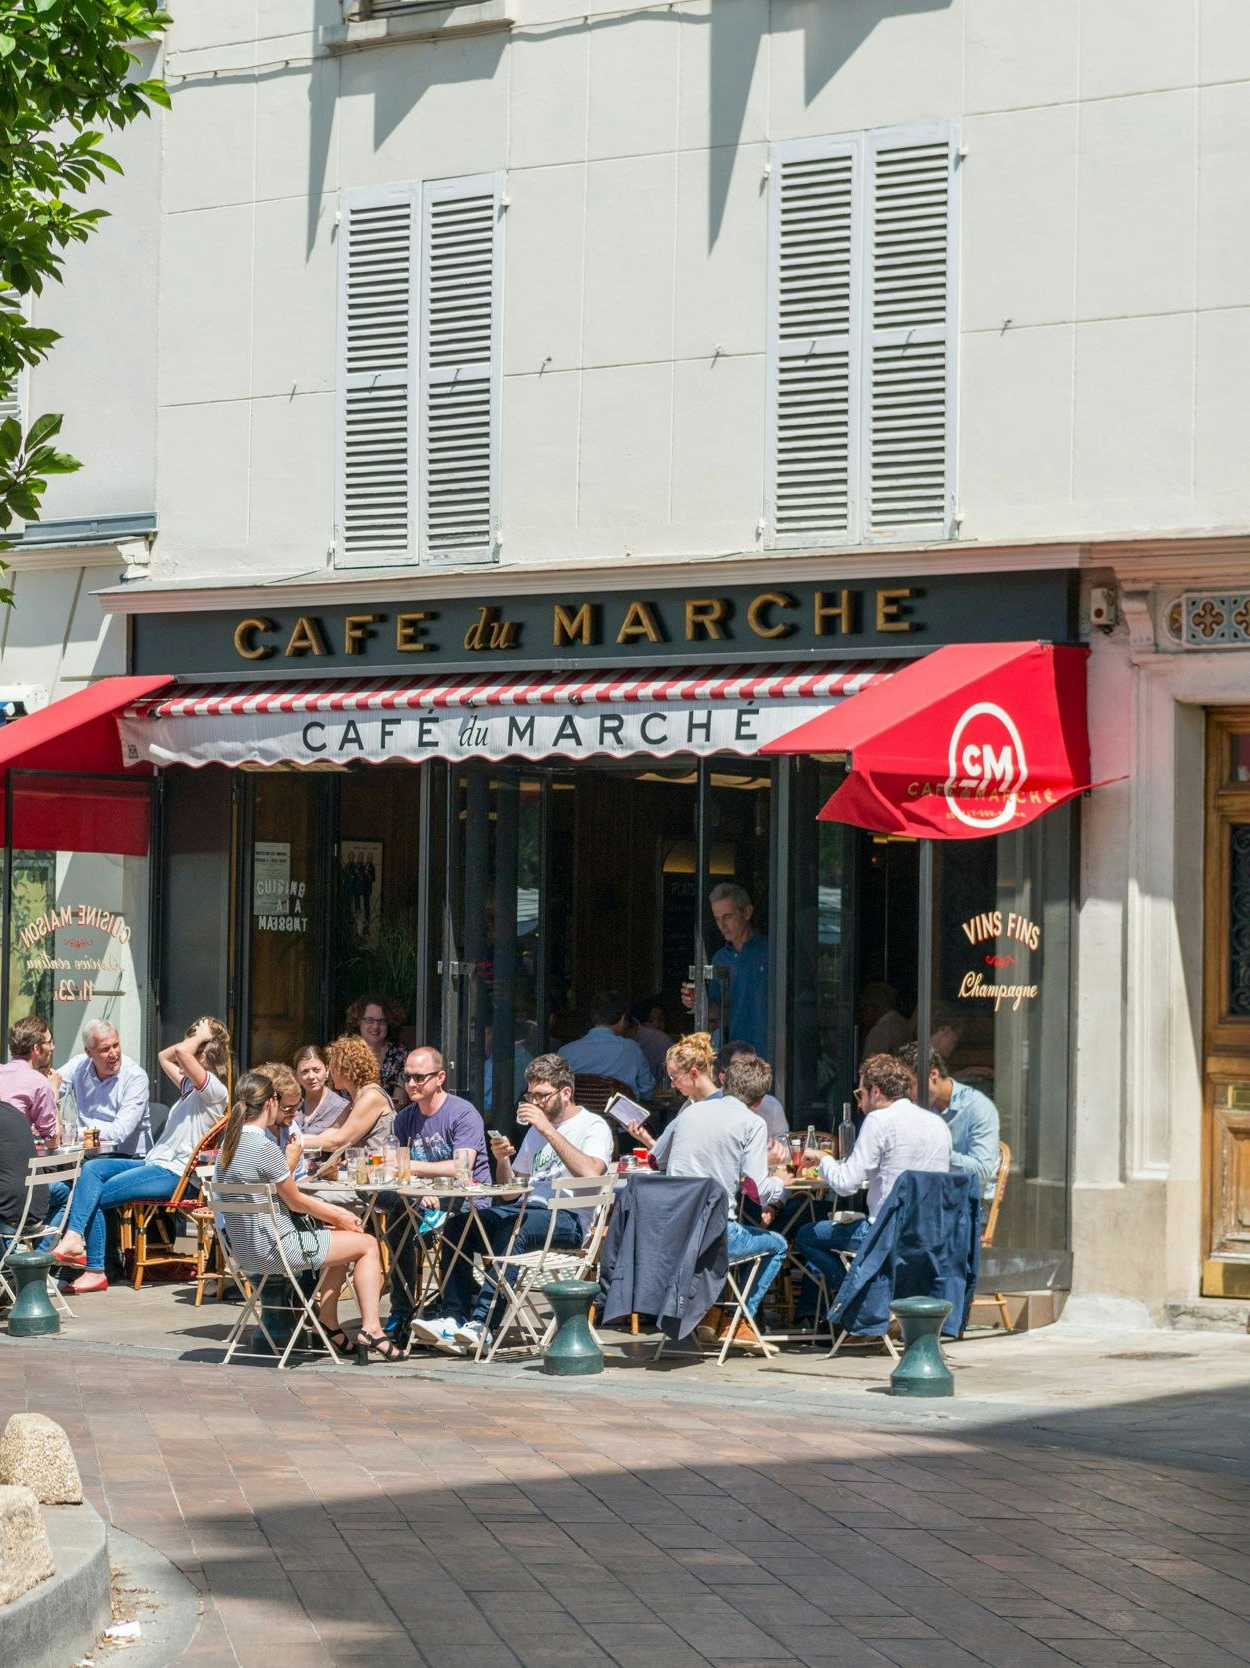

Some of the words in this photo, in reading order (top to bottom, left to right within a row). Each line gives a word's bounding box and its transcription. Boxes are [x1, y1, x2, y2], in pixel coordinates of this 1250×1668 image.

[233, 610, 432, 661] CAFE
[463, 605, 519, 652] du
[553, 587, 918, 647] MARCHE
[301, 708, 440, 752] CAFÉ
[459, 711, 489, 748] du
[506, 699, 761, 748] MARCHÉ
[962, 743, 1014, 792] CM
[962, 910, 1003, 946] VINS
[1006, 911, 1041, 952] FINS
[957, 971, 1039, 1013] Champagne
